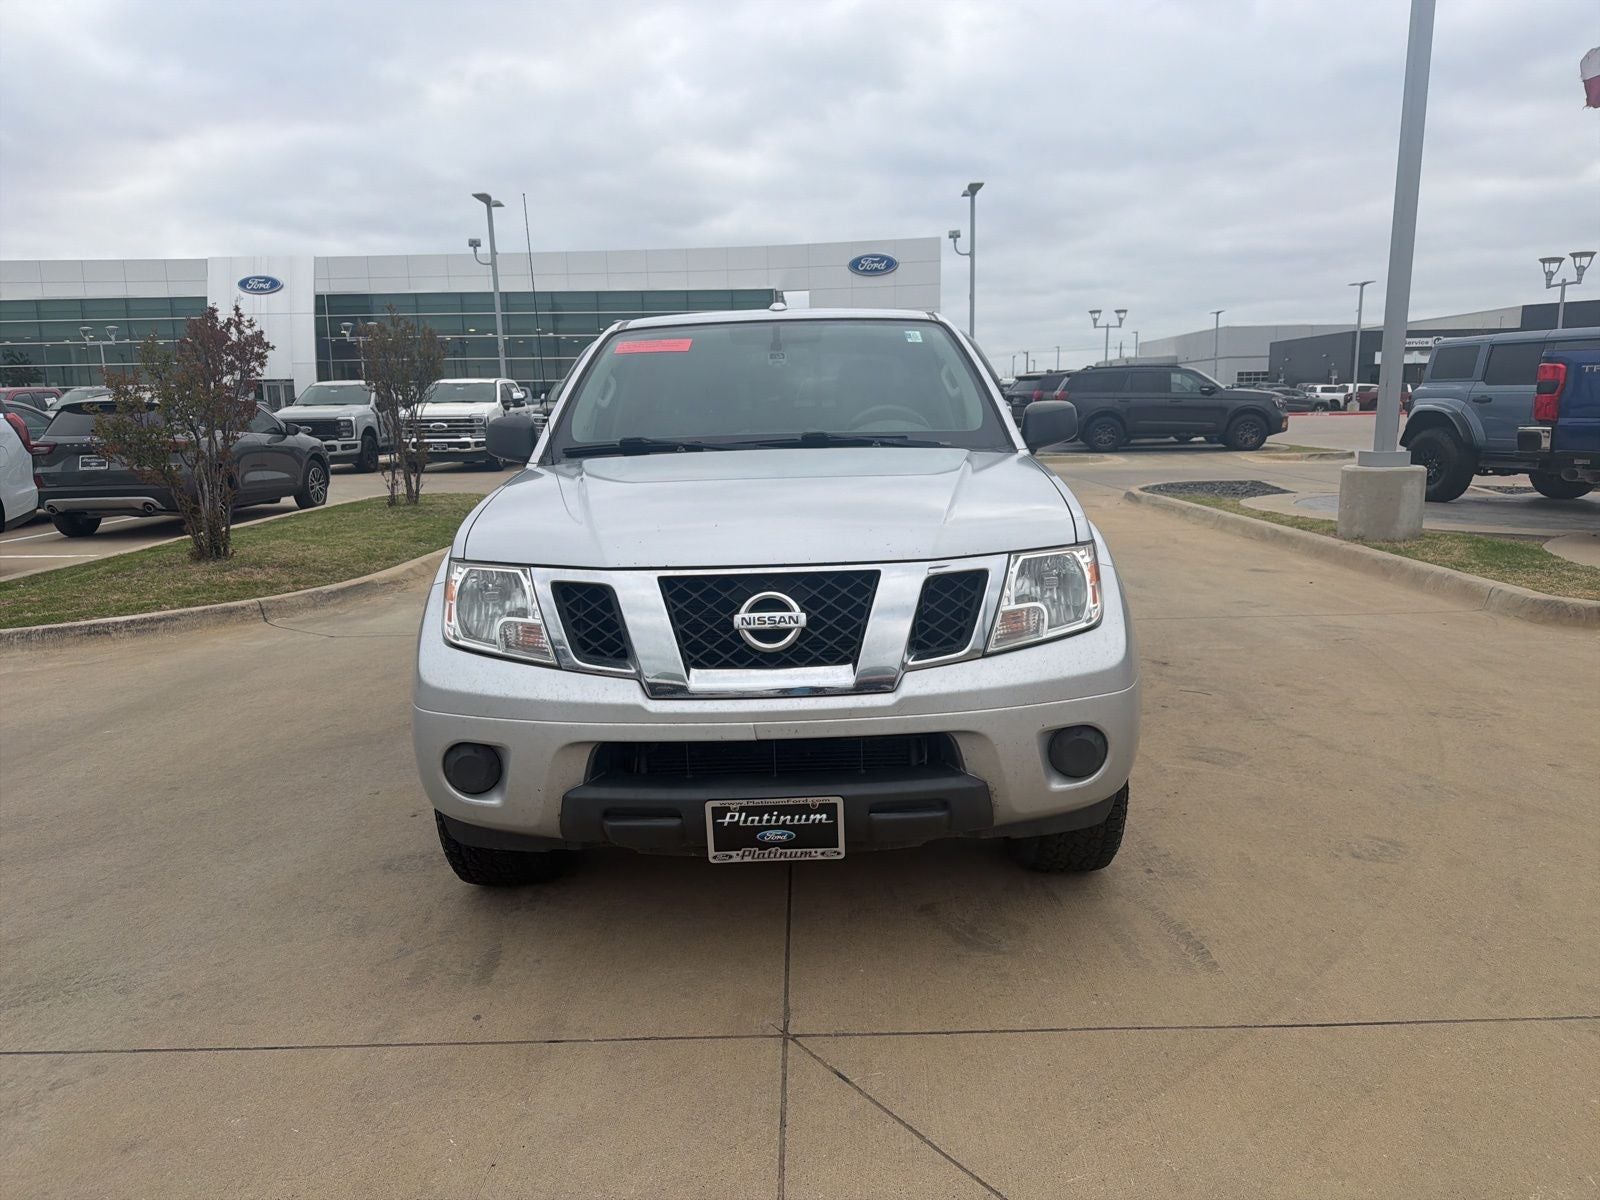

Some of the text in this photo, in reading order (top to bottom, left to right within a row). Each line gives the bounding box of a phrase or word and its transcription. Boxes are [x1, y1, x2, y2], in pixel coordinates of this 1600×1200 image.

[858, 257, 888, 270] Ford
[246, 278, 271, 289] Ford
[741, 615, 799, 626] NISSAN
[719, 798, 831, 806] www.PlatinumFord.com
[716, 811, 833, 826] Platinum
[764, 831, 788, 841] Ford
[740, 847, 818, 861] Platinum
